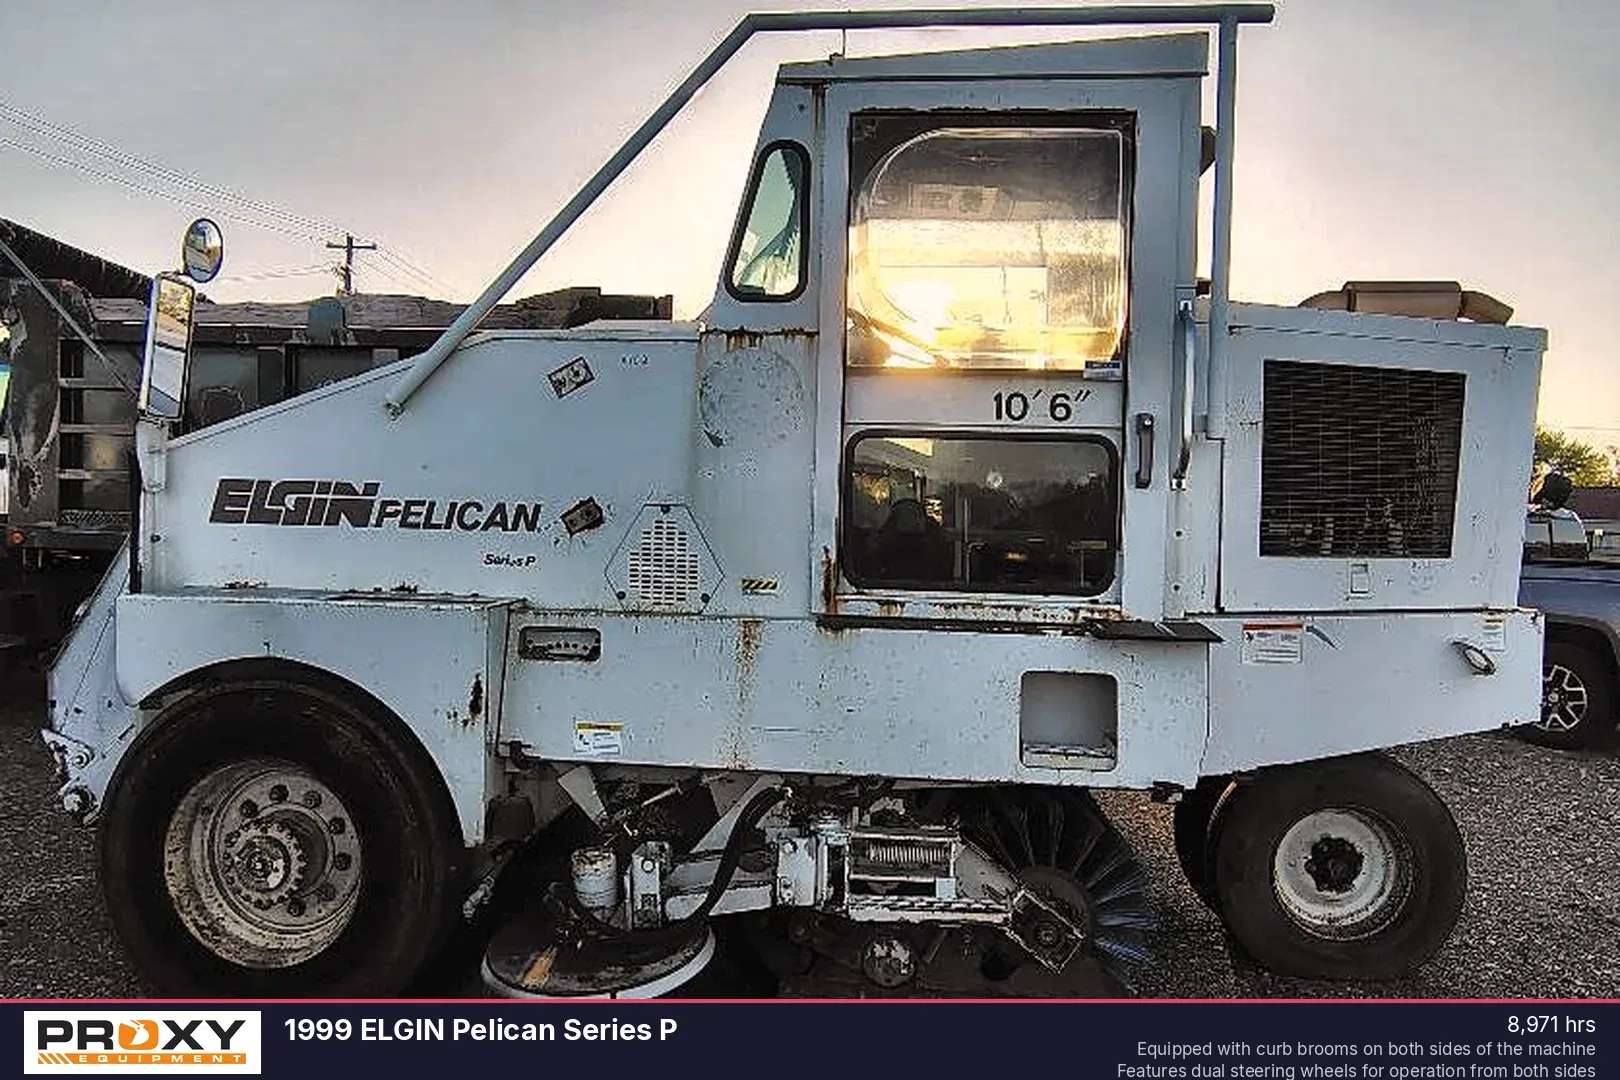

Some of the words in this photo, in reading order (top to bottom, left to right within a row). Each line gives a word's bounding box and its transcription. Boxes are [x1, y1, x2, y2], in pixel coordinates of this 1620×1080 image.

[209, 478, 380, 528] ELGIN
[374, 499, 541, 532] PELICAN
[525, 556, 537, 568] P
